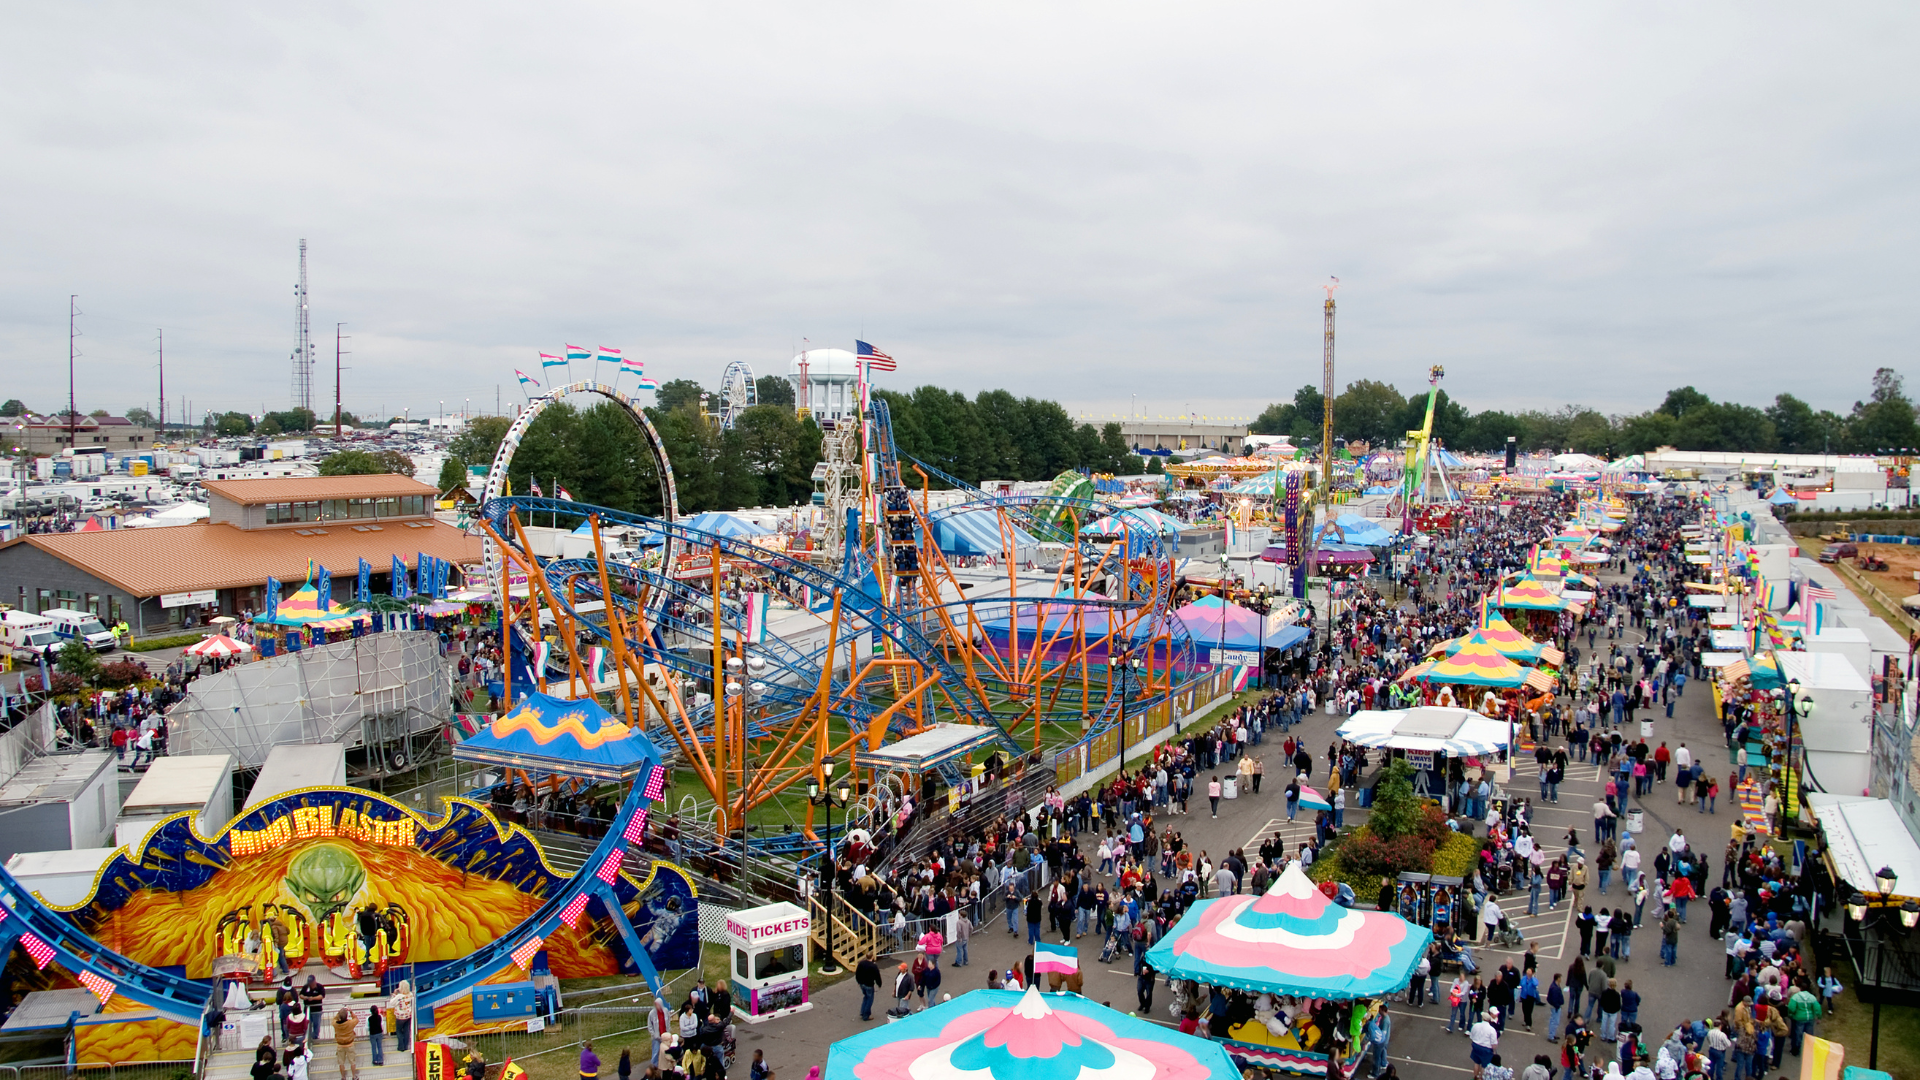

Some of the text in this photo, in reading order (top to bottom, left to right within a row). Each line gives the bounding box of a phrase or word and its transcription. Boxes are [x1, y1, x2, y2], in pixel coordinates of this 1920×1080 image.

[229, 805, 416, 856] MIND BLASTER
[727, 918, 809, 940] RIDE TICKETS
